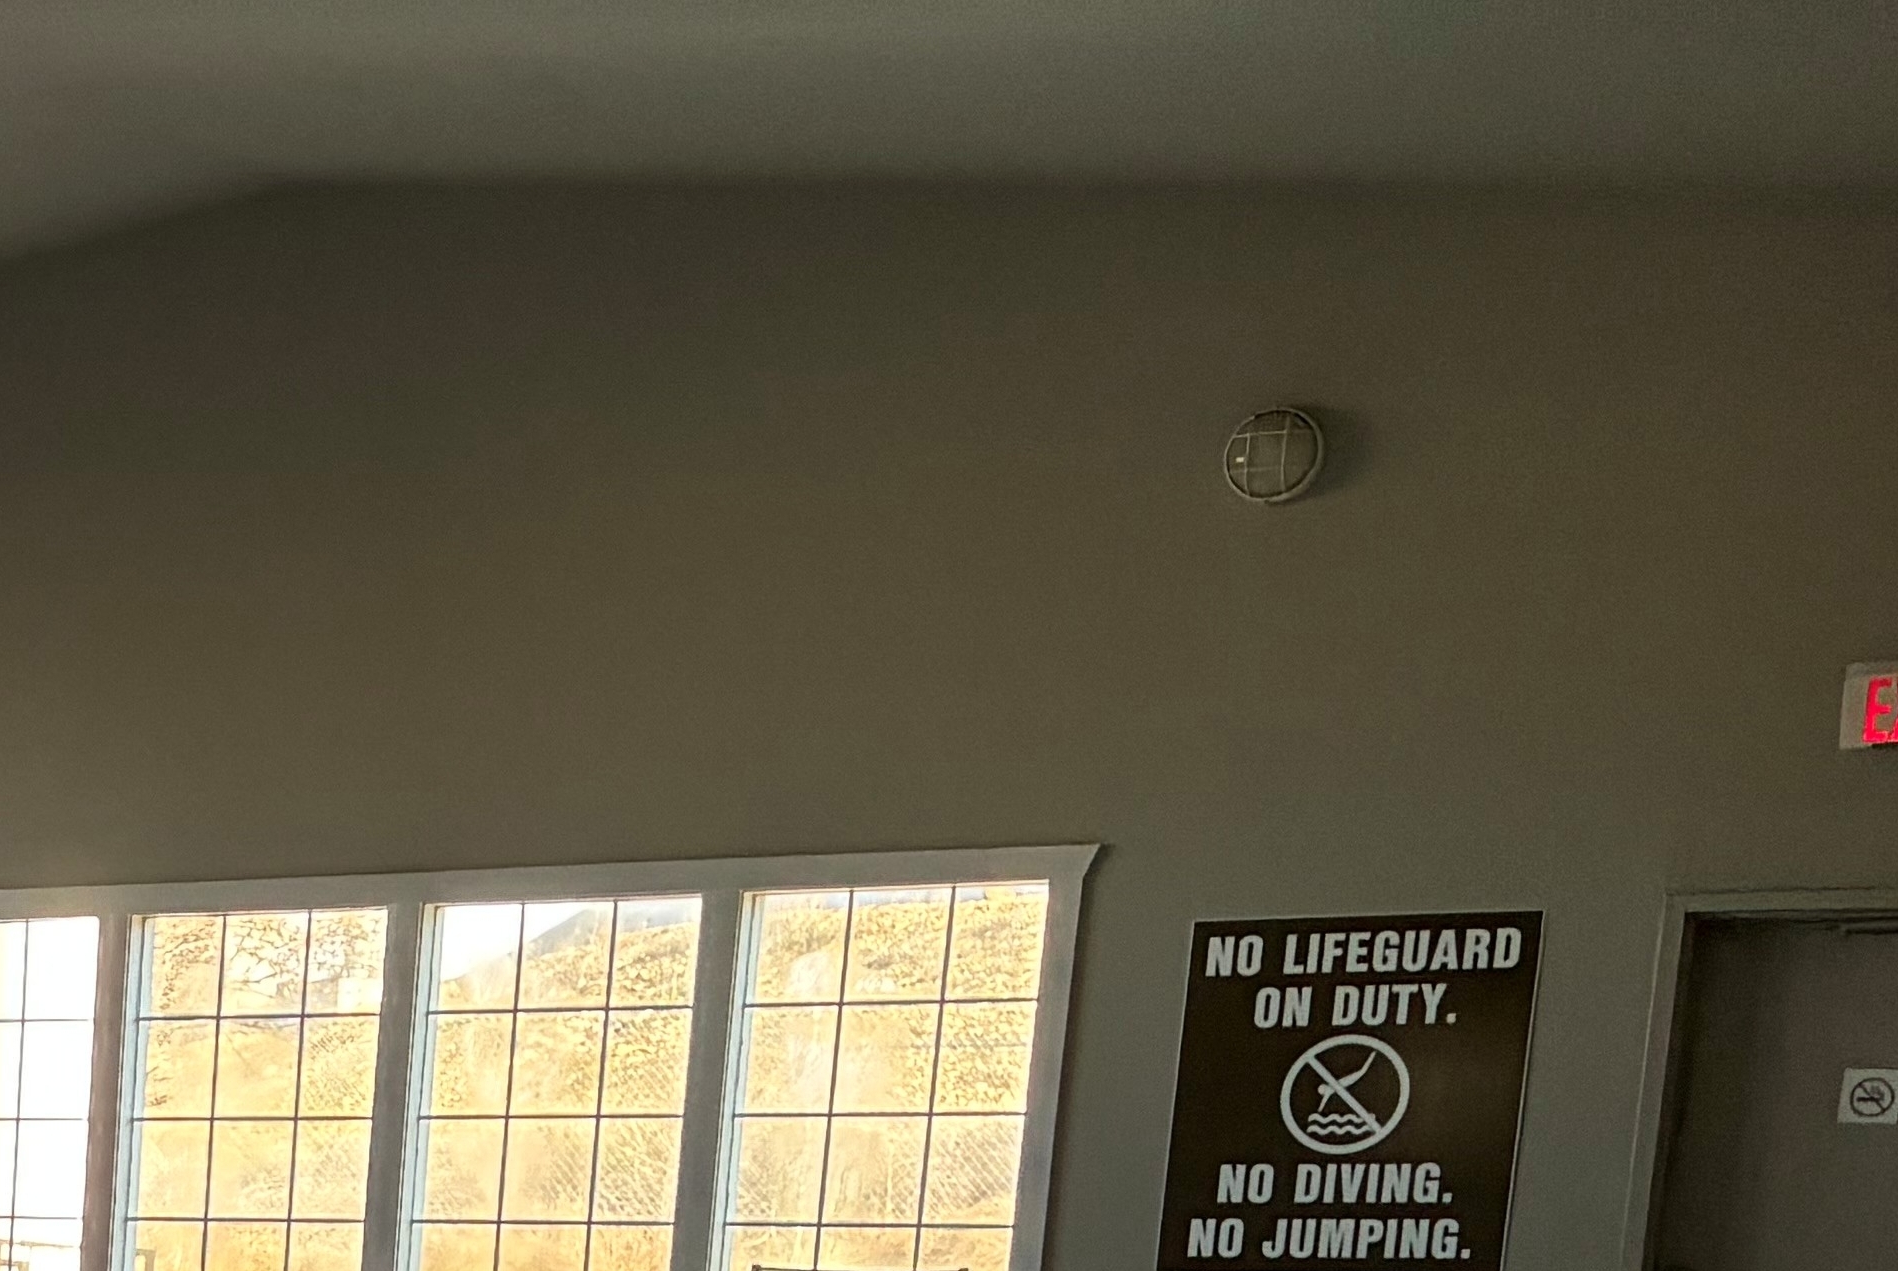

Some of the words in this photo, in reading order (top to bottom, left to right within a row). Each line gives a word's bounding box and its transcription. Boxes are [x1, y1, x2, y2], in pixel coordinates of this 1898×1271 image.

[1206, 935, 1263, 977] NO
[1283, 927, 1522, 975] LIFEGUARD
[1254, 986, 1312, 1028] ON
[1332, 983, 1457, 1027] DUTY.
[1217, 1164, 1274, 1204] NO
[1294, 1161, 1453, 1205] DIVING.
[1187, 1218, 1245, 1258] NO
[1262, 1218, 1471, 1260] JUMPING.
